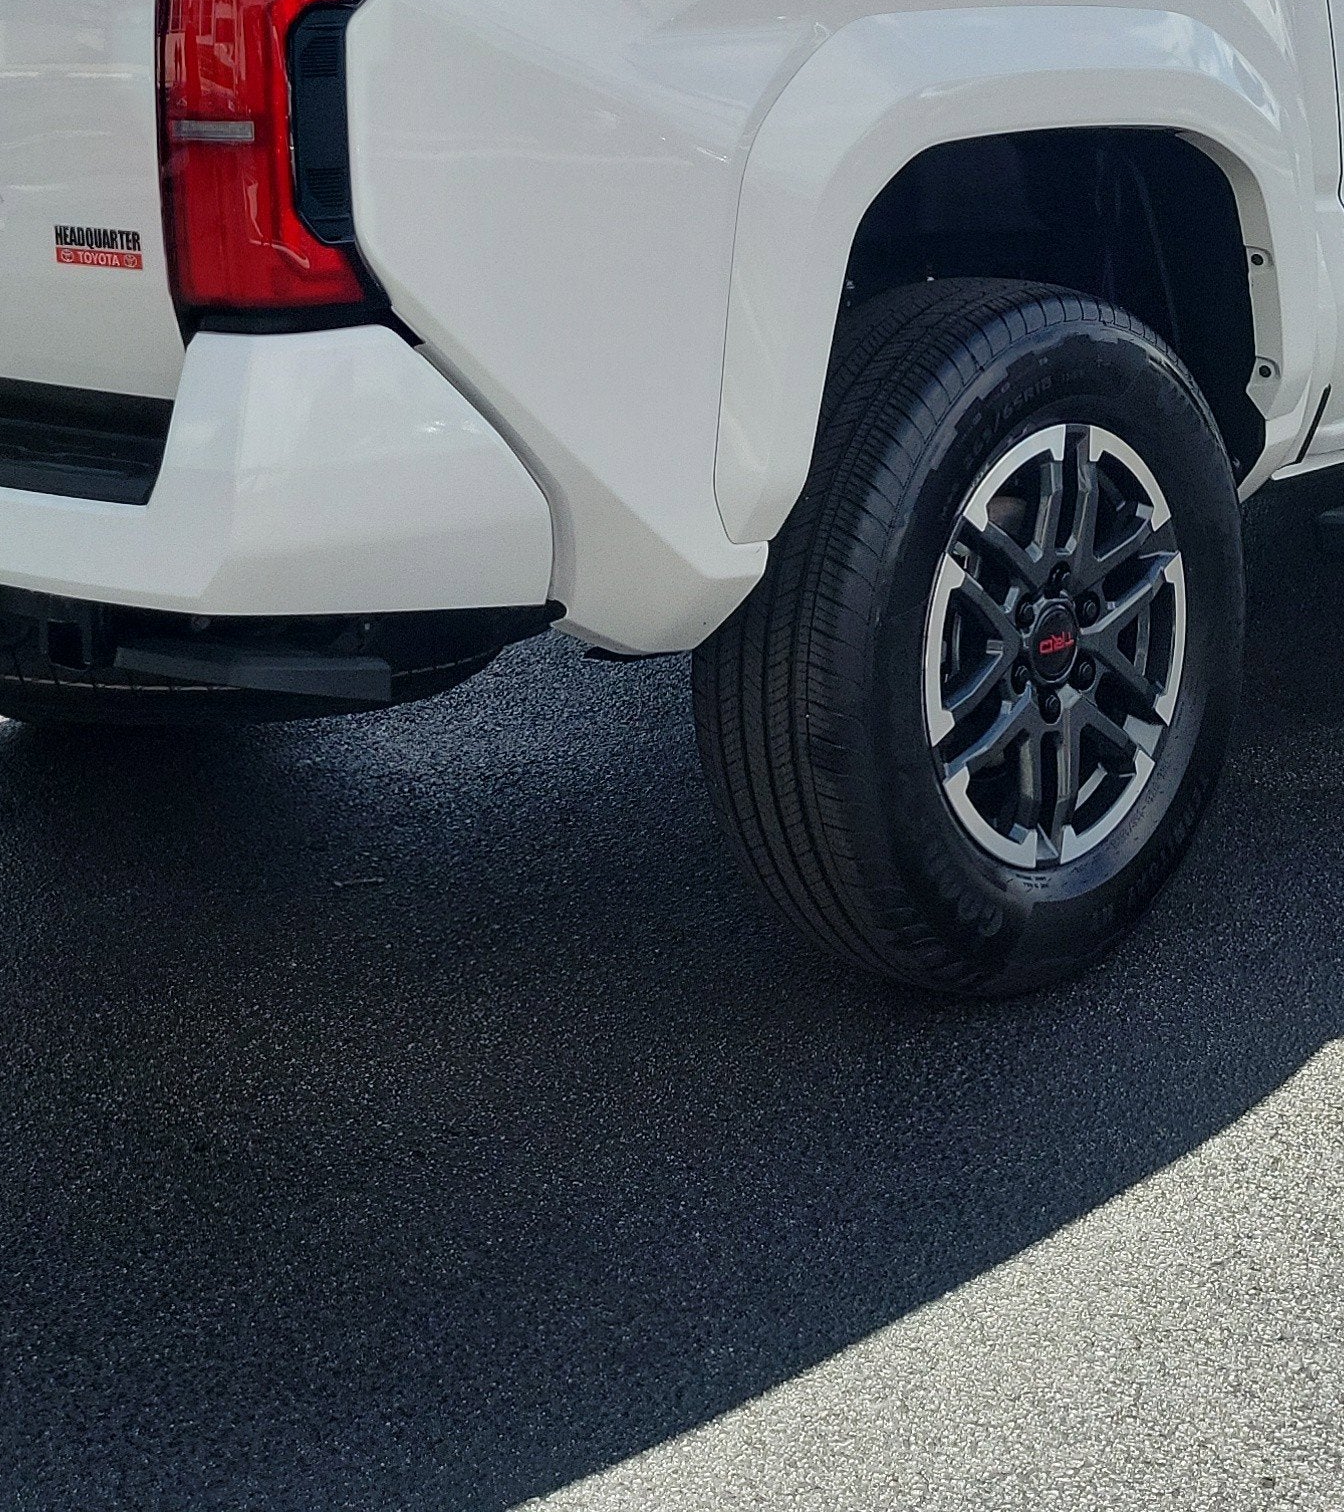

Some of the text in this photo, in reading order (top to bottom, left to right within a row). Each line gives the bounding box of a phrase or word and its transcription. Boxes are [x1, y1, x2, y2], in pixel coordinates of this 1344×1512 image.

[54, 225, 141, 251] HEADQUARTER
[77, 251, 120, 266] TOYOTA
[1039, 631, 1075, 654] TRD
